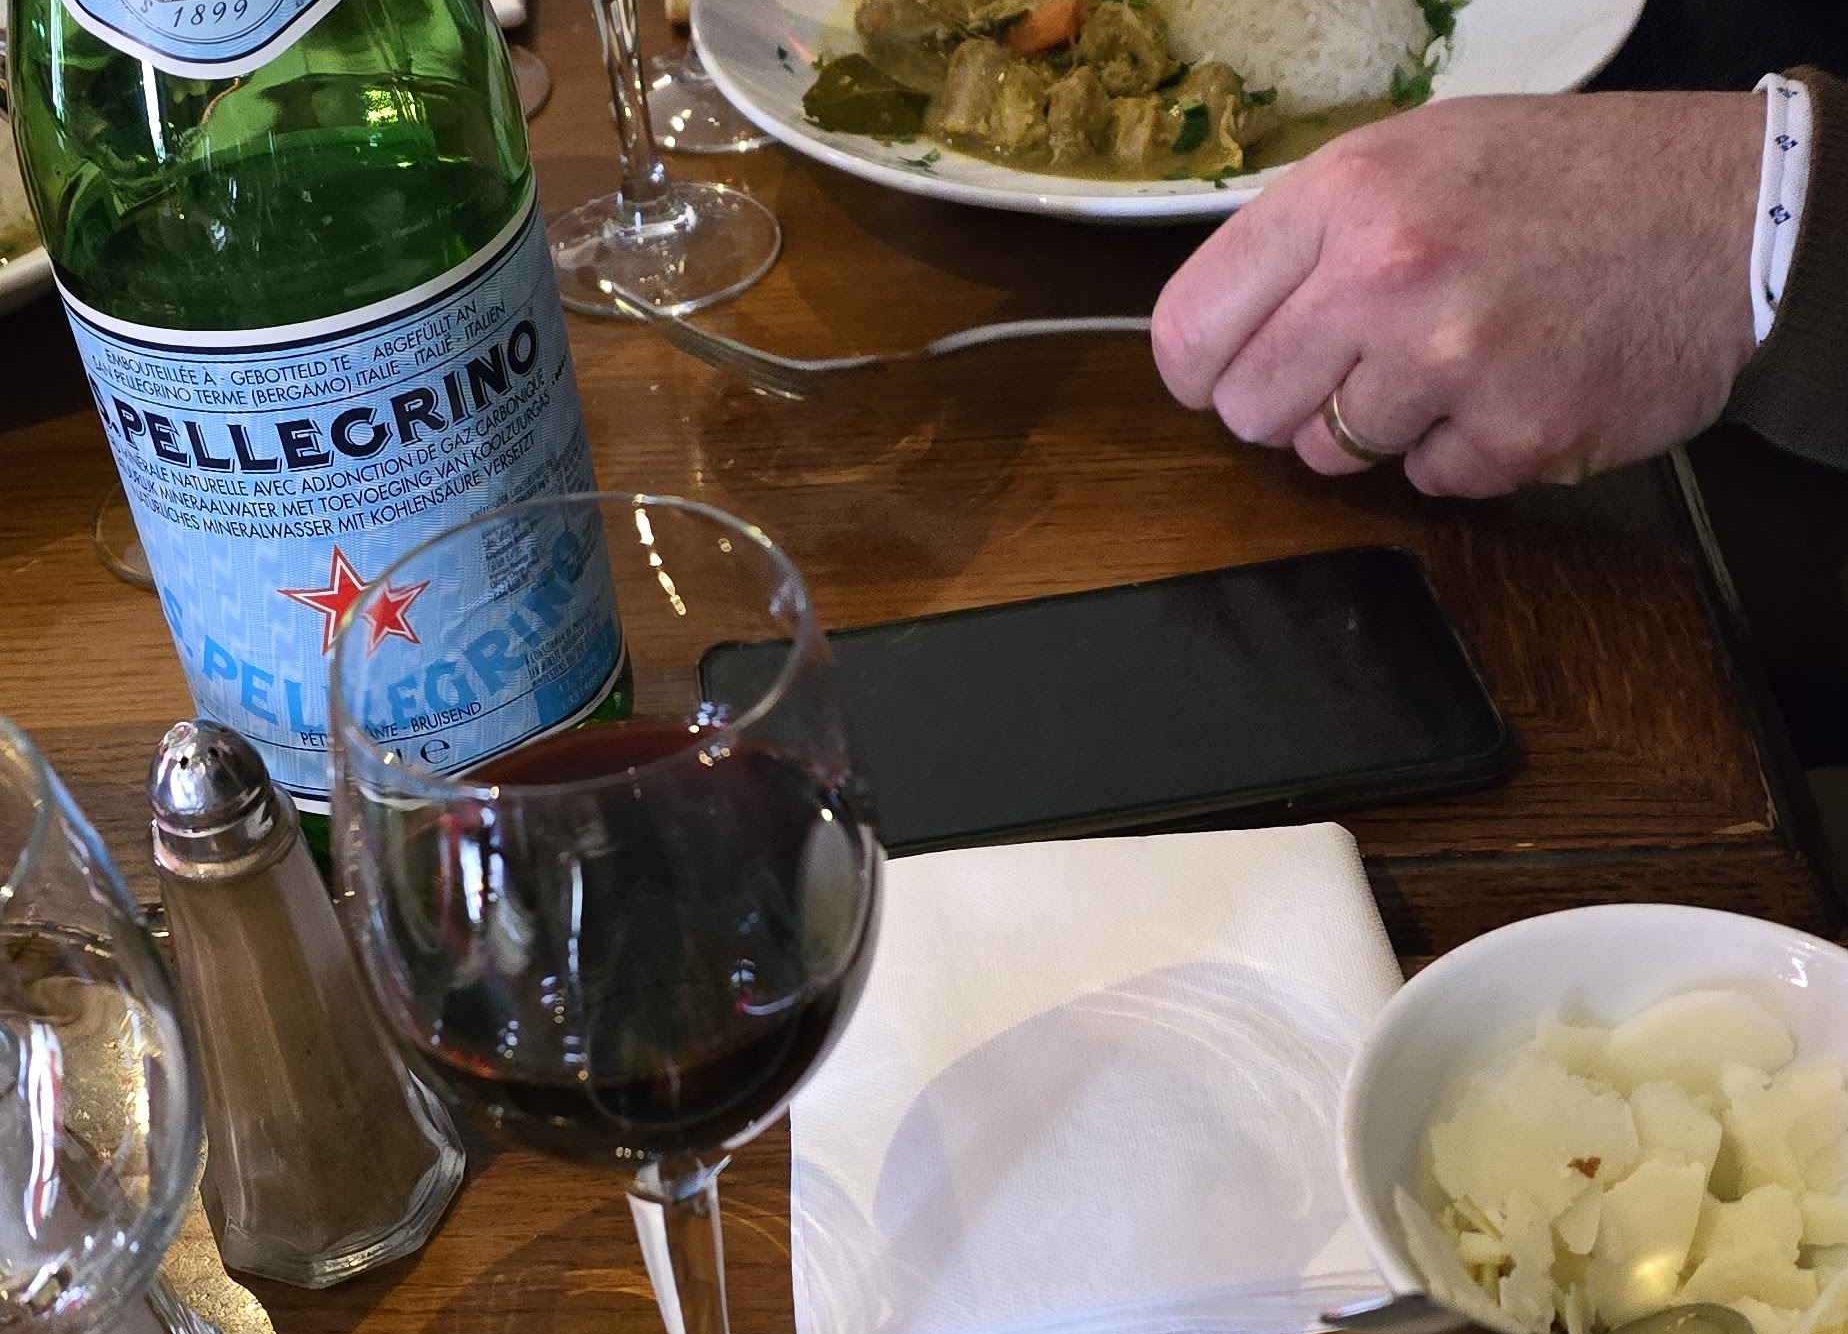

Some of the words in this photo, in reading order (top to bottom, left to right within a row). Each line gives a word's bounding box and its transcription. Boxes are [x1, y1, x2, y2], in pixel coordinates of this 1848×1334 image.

[87, 319, 539, 475] S.PELLEGRINO
[105, 348, 199, 385] EMBOUTEILLÉE
[231, 361, 328, 386] GEBOTTELD
[331, 354, 352, 373] TE
[373, 315, 453, 362] ABGEFÜLLT
[456, 300, 477, 325] AN
[114, 368, 191, 403] PELLEGRINO
[194, 389, 248, 406] TERME
[251, 375, 351, 407] (BERGAMO)
[355, 360, 401, 386] ITALIE
[464, 300, 506, 341] ITALIEN
[159, 484, 278, 519] MINERAALWATER
[282, 498, 314, 518] MET
[320, 471, 433, 511] TOEVOEGING
[434, 452, 469, 479] VAN
[469, 392, 550, 463] KOOLZUURGAS
[171, 469, 249, 498] NATURELLE
[253, 478, 297, 498] AVEC
[301, 450, 413, 495] ADJONCTION
[417, 443, 438, 467] DE
[441, 428, 475, 455] GAZ
[476, 369, 545, 437] CARBONIQUE
[202, 517, 335, 540] MINERALWASSER
[338, 512, 366, 534] MIT
[369, 470, 480, 527] KOHLENSÄURE
[483, 430, 537, 479] VERSETZT
[299, 722, 399, 747] PÉTANTE
[411, 701, 482, 733] BRUISEND
